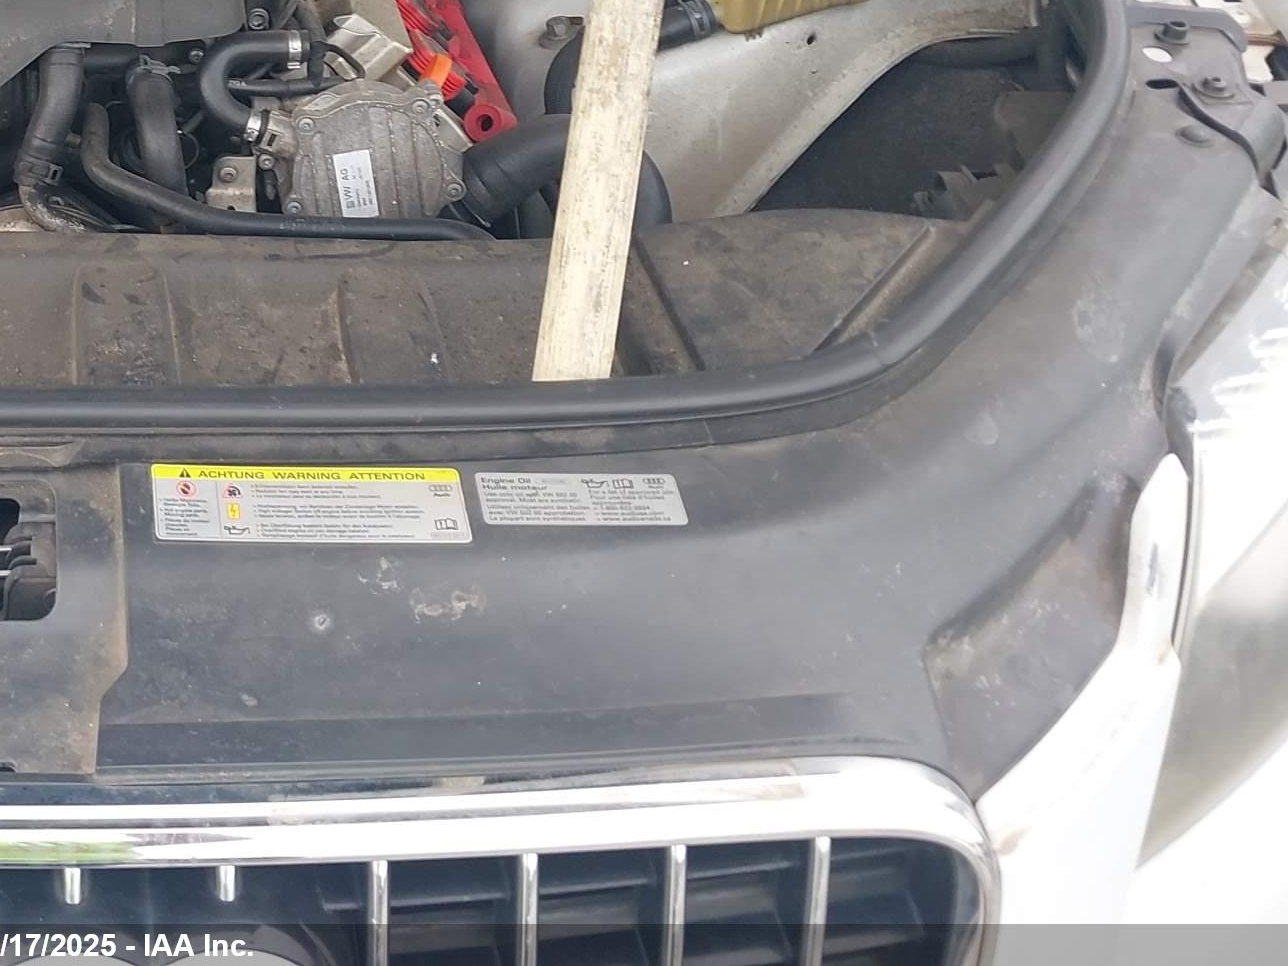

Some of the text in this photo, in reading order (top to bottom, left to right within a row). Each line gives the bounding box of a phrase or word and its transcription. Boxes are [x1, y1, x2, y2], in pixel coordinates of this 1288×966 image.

[340, 168, 350, 181] AG
[198, 471, 426, 481] ACHTUNG WARNING ATTENTION
